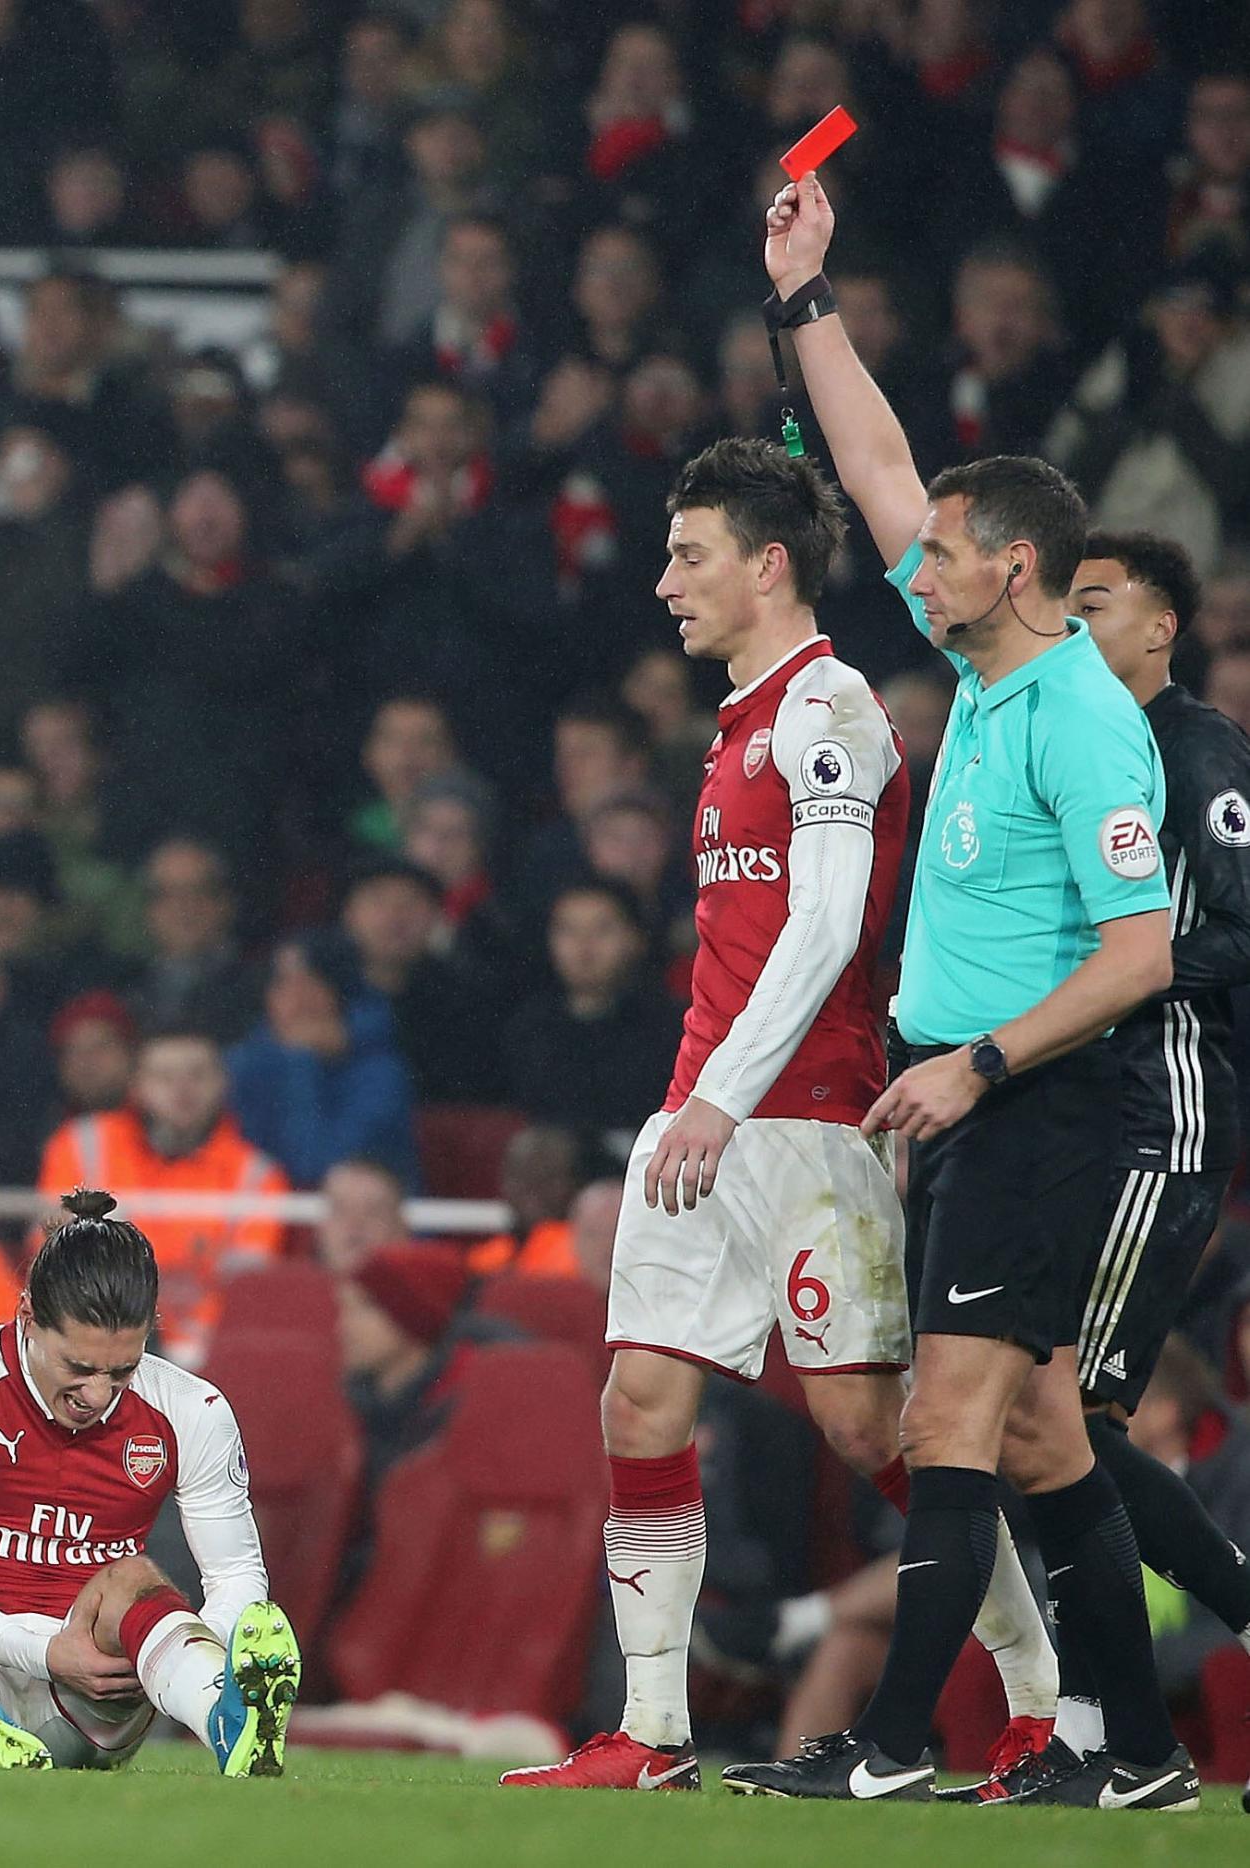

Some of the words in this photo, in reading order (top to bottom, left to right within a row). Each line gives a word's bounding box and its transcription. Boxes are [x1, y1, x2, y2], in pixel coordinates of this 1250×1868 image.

[701, 805, 721, 841] Fly
[807, 804, 871, 823] Captain
[1110, 821, 1154, 851] EA
[1111, 846, 1157, 866] SPORTS
[787, 1248, 831, 1322] 6
[30, 1503, 93, 1542] Fly
